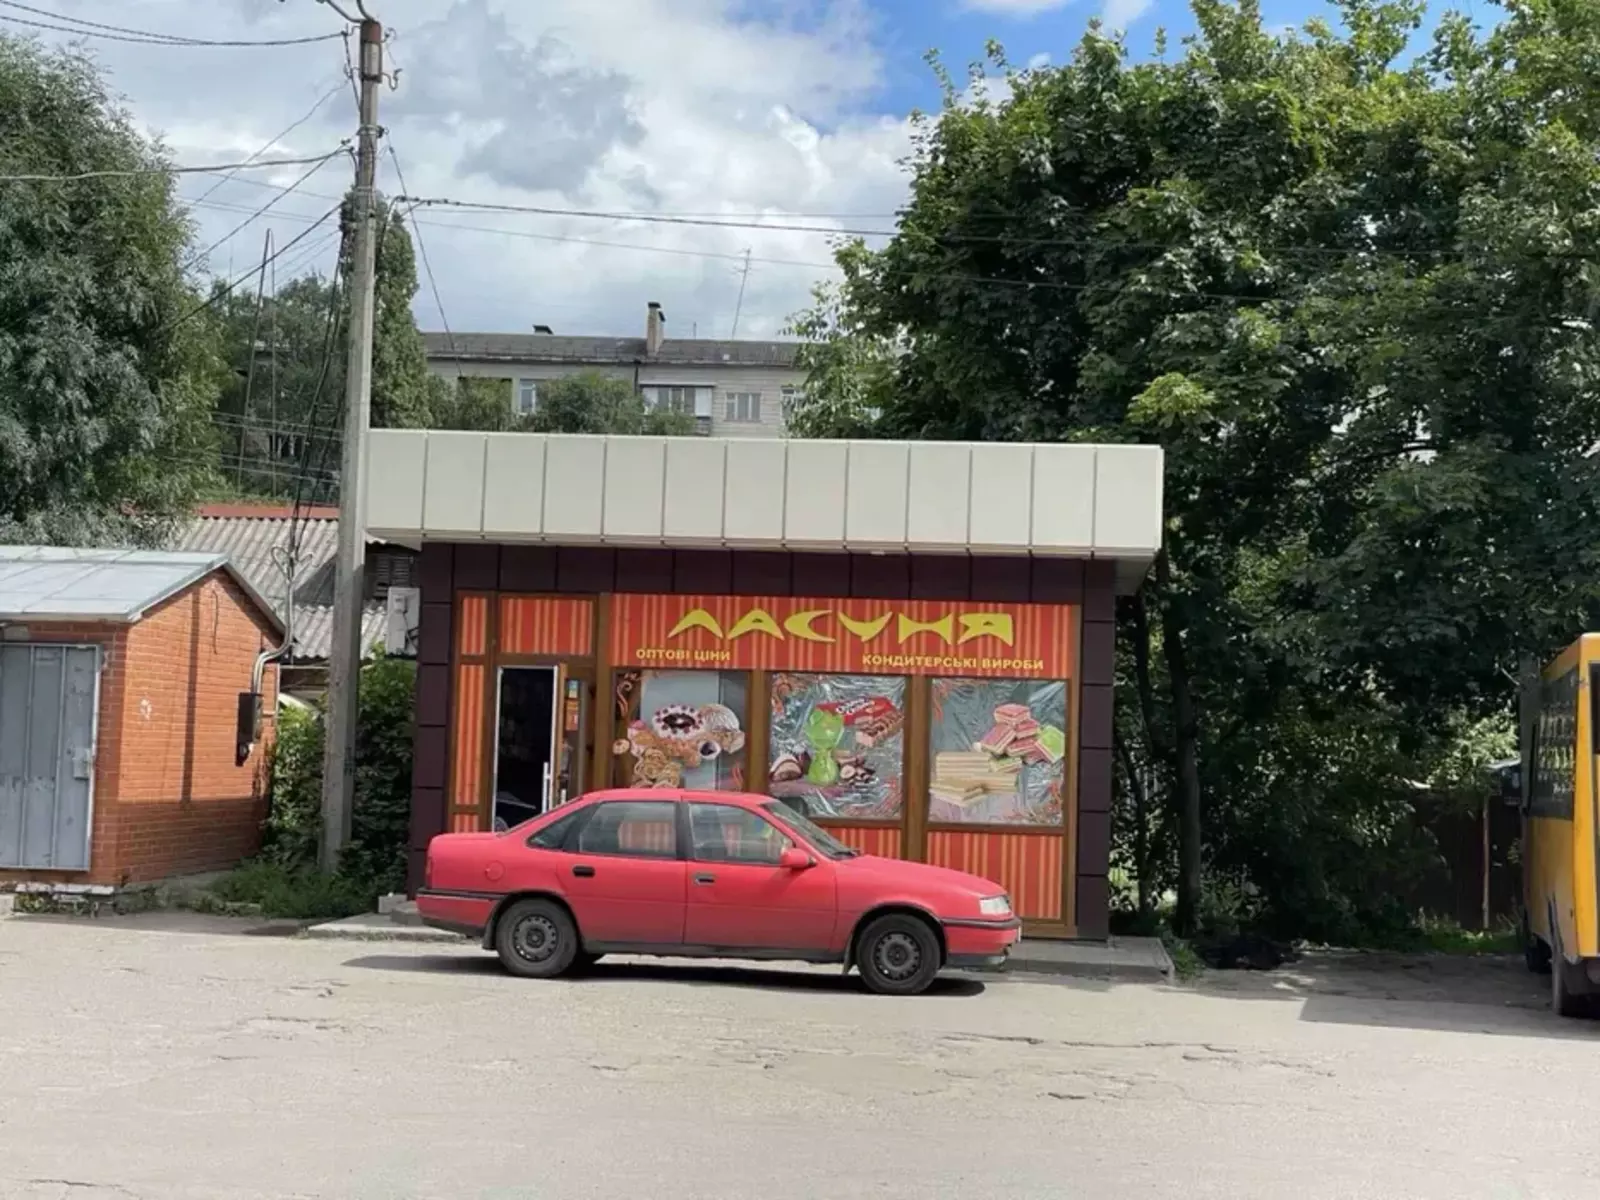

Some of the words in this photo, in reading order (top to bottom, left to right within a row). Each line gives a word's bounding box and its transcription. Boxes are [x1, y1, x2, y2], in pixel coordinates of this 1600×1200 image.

[667, 608, 1014, 647] ЛАСУНЯ
[635, 649, 690, 661] ОПТОВІ
[694, 650, 730, 662] ЦІНИ
[862, 654, 977, 668] КОНДИТЕРСЬКІ
[981, 658, 1044, 670] ВИРОБИ
